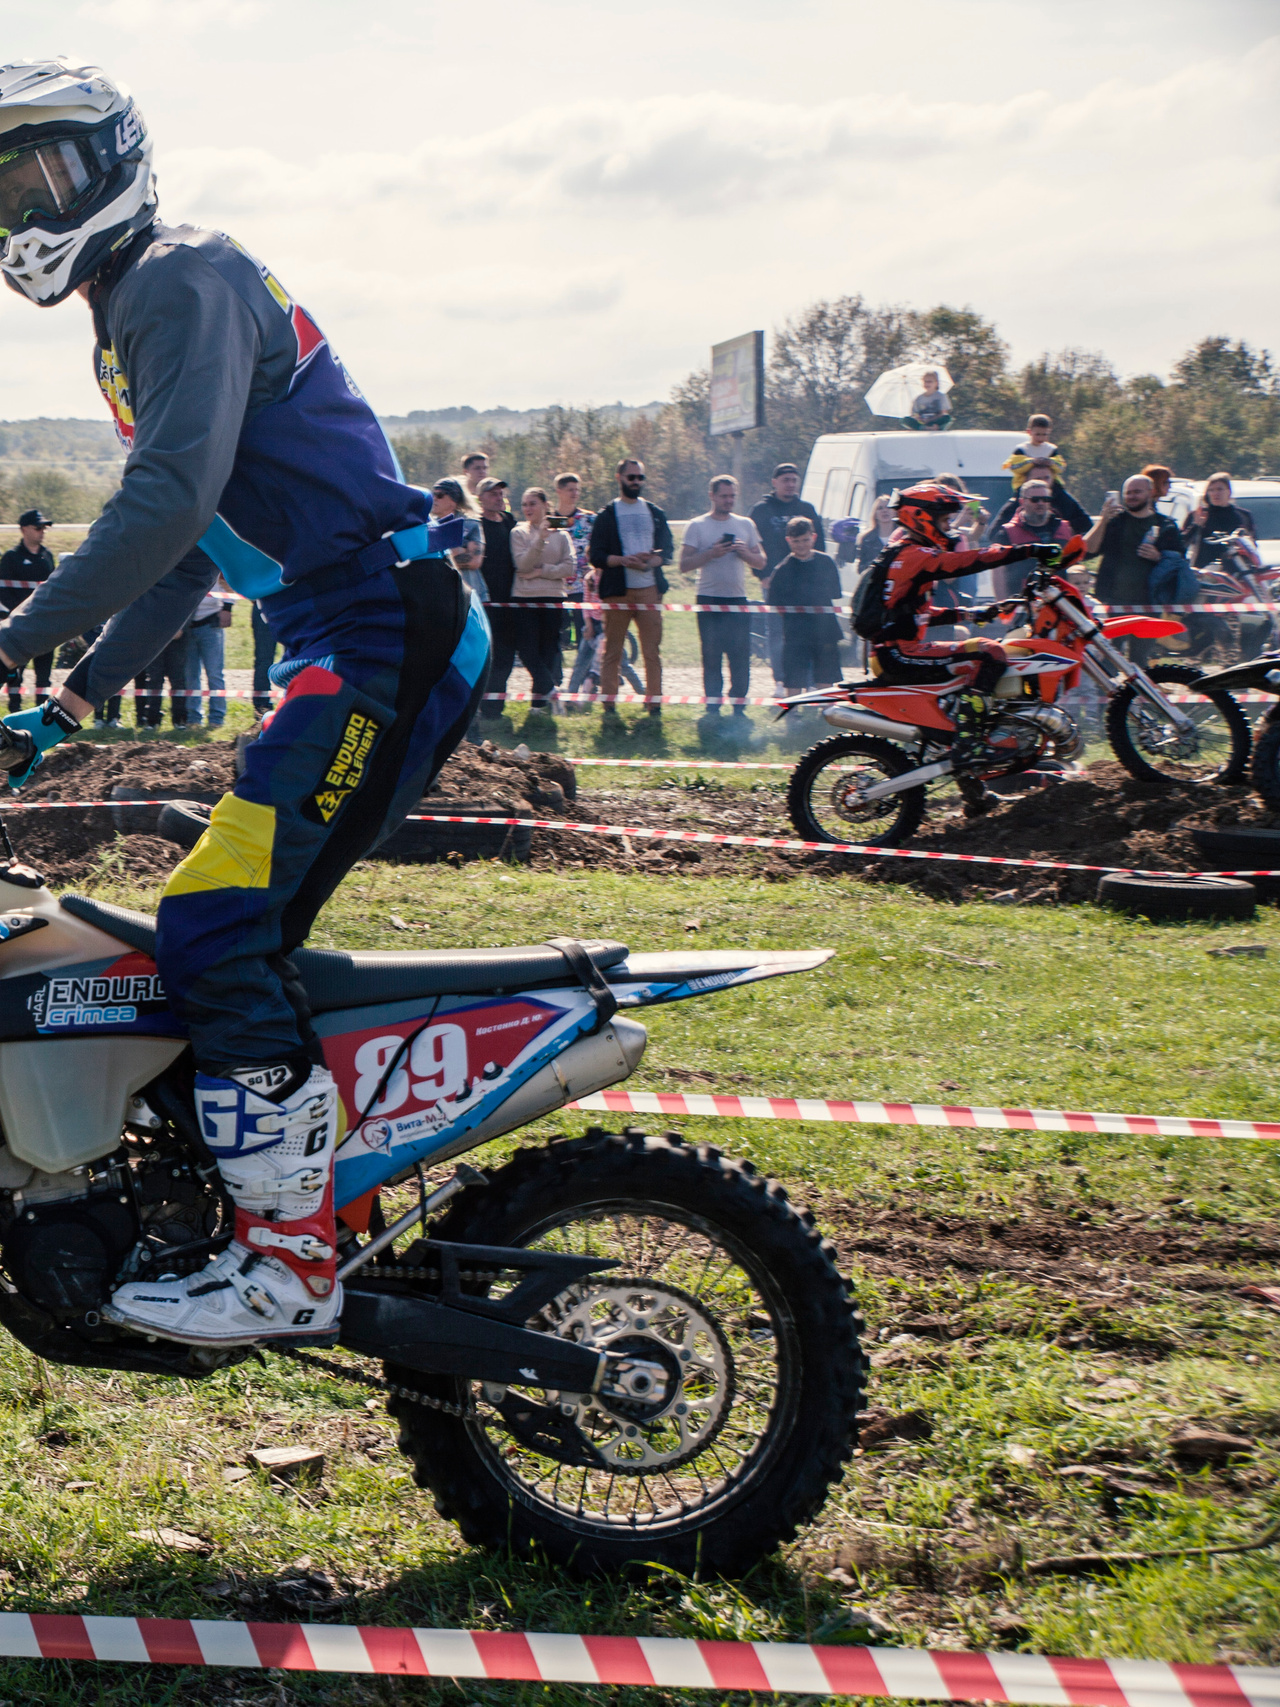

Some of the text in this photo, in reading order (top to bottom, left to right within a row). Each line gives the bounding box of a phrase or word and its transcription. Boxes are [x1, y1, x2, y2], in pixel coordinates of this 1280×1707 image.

[325, 713, 366, 787] ENDURO
[344, 719, 379, 788] ELEMENT
[50, 975, 167, 1004] ENDURO
[48, 1004, 137, 1026] crimea
[475, 1019, 520, 1036] Костенко
[247, 1067, 288, 1087] SG 12
[354, 1023, 468, 1117] 89
[194, 1088, 238, 1147] G
[396, 1112, 447, 1132] Вита-М
[304, 1121, 329, 1157] G
[291, 1308, 316, 1325] G
